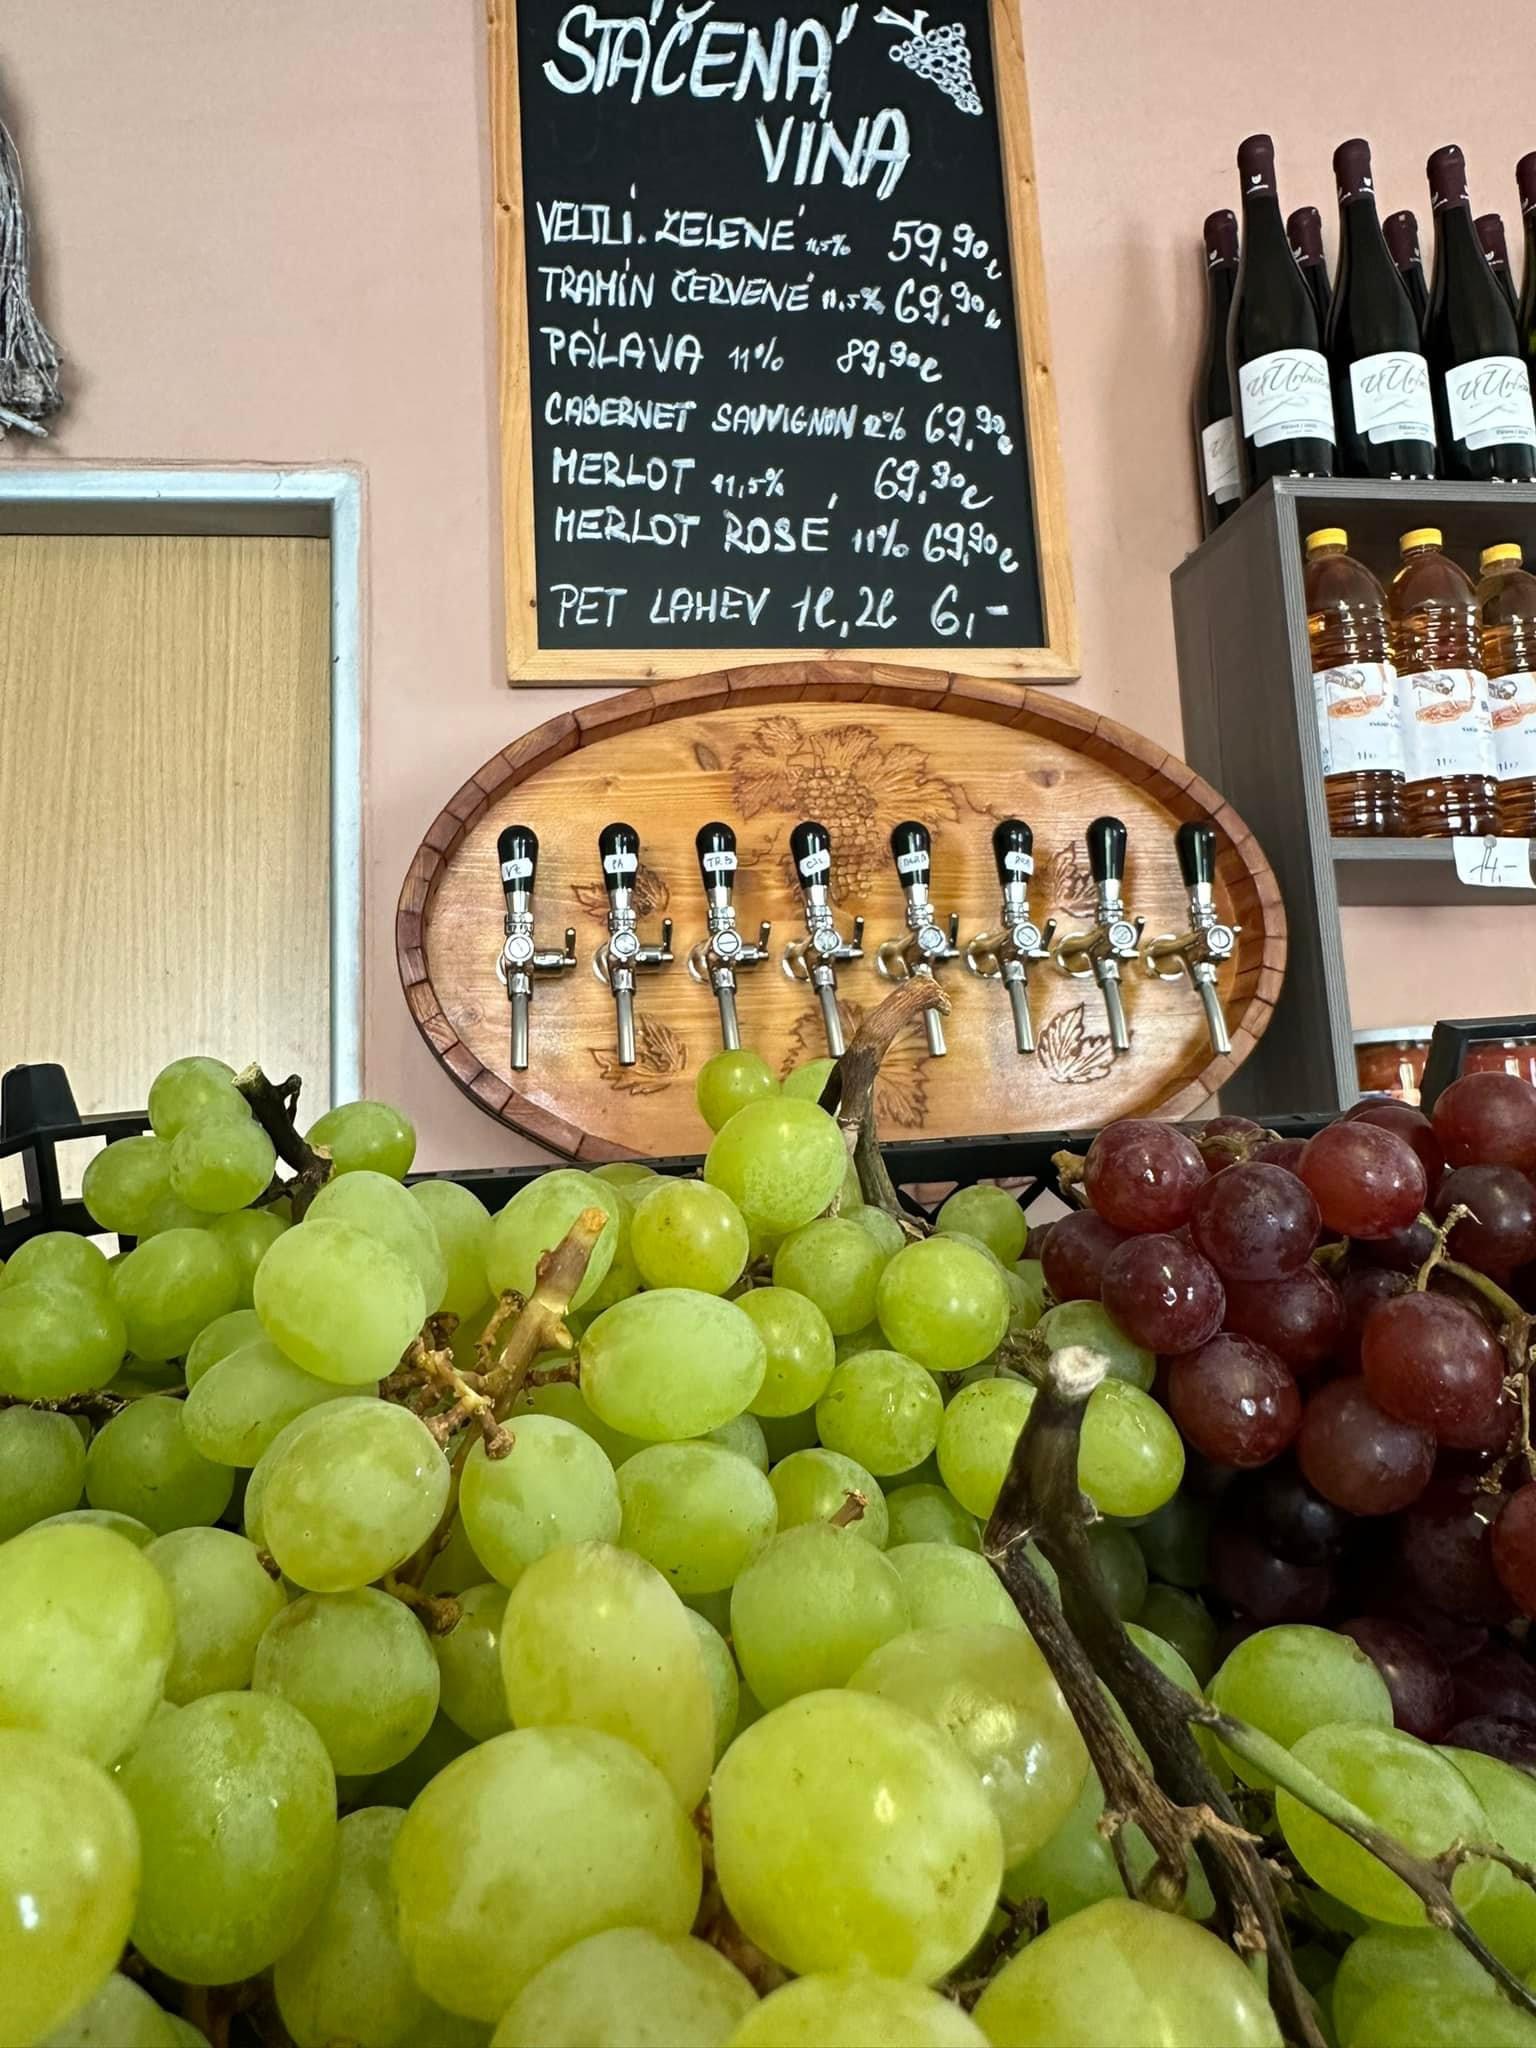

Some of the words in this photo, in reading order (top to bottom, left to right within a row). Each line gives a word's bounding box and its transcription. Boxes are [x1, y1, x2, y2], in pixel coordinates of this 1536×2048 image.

[542, 0, 859, 104] STÁČENÁ
[755, 92, 911, 200] VÍNA
[655, 203, 806, 252] ZELENÉ
[537, 257, 655, 309] TRAMÍN
[671, 268, 816, 313] ČERVENÉ
[540, 318, 704, 375] PÁLAVA
[729, 336, 785, 373] 11%
[544, 391, 697, 433] CABERNET
[711, 402, 858, 440] SAUVIGNON
[552, 446, 696, 495] MERLOT
[711, 468, 785, 498] 11,5%
[555, 505, 701, 549] MERLOT
[722, 493, 838, 554] ROSÉ
[852, 518, 910, 558] 11%
[549, 583, 628, 628] PET
[650, 585, 771, 626] LAHEV
